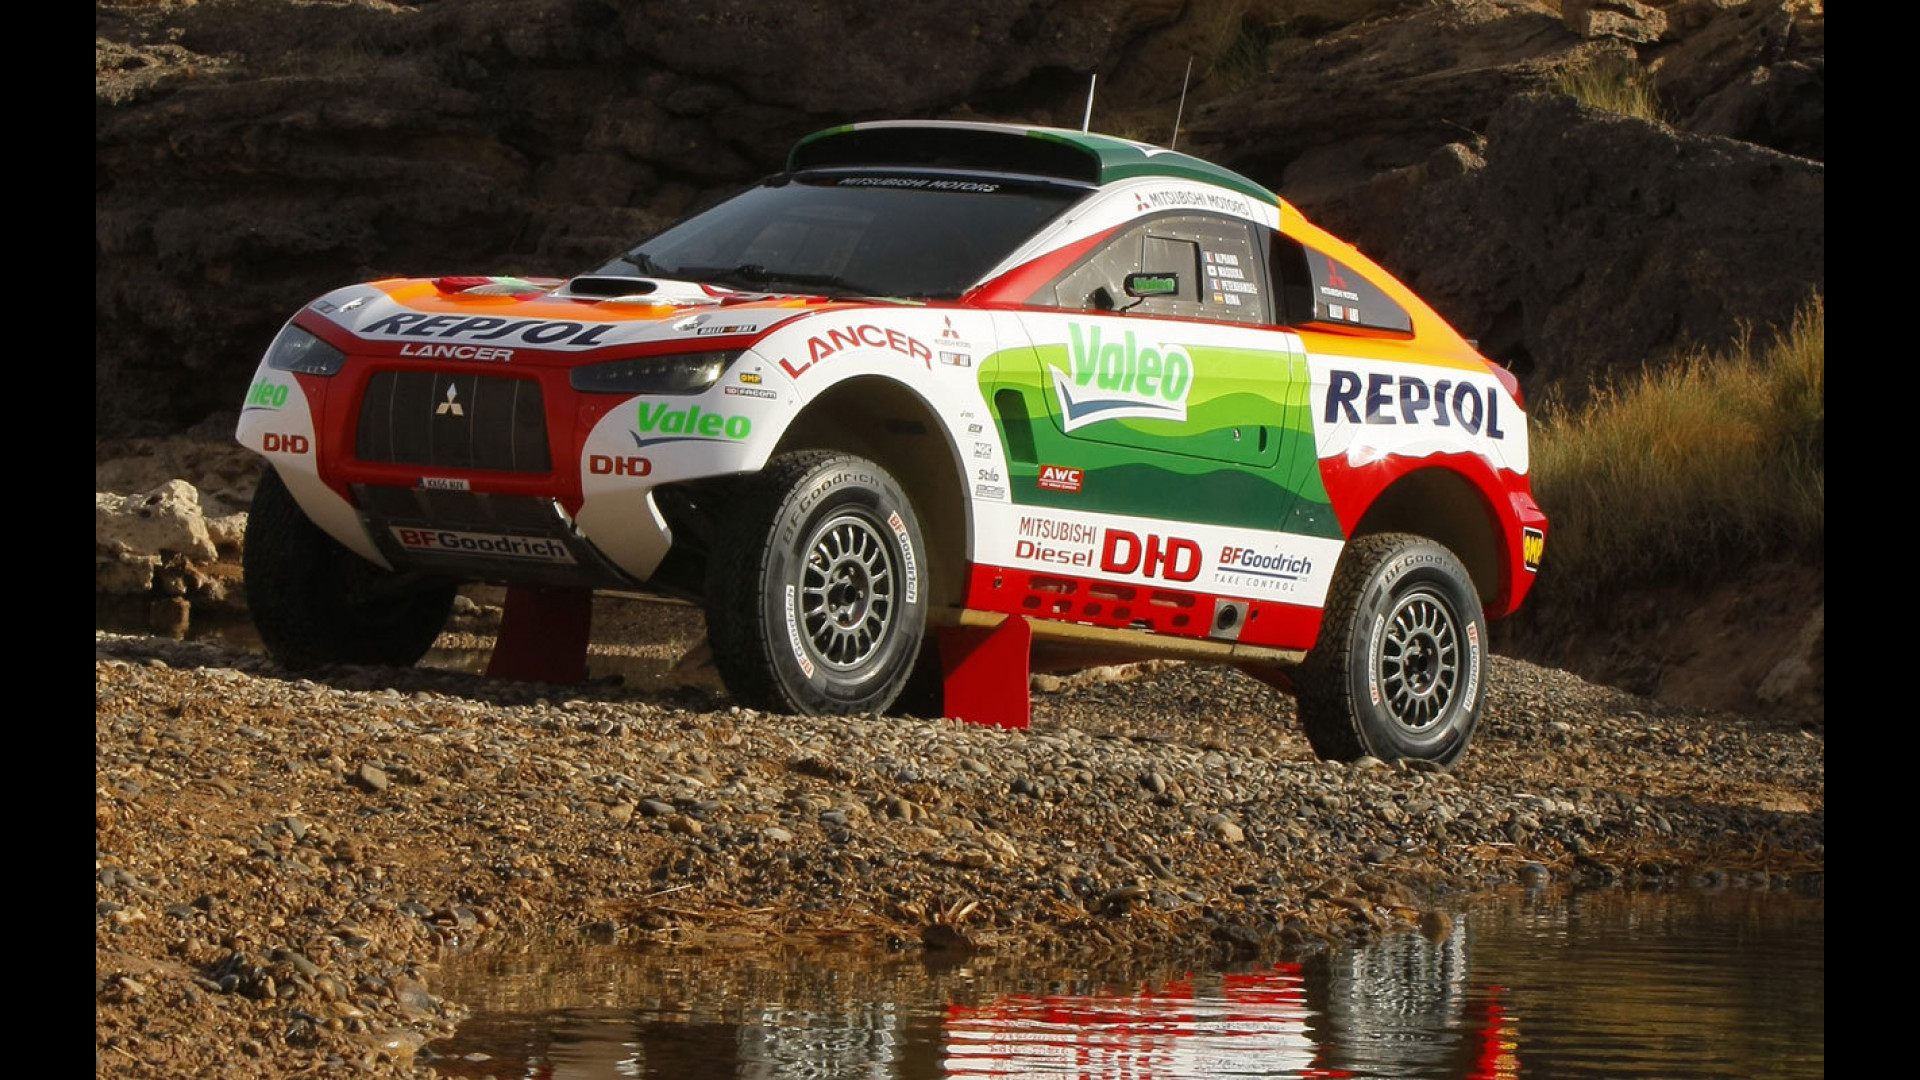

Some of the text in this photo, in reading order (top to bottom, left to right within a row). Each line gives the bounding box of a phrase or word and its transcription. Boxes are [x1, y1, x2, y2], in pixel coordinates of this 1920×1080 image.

[838, 177, 1000, 194] MITSUBISHI MOTORS
[1149, 191, 1250, 216] MITSUBISHI MOTORS
[359, 312, 618, 346] REPSOL
[400, 343, 515, 362] LANCER
[779, 324, 933, 380] LANCER
[1068, 322, 1190, 402] Valeo
[1323, 369, 1505, 440] REPSOL
[638, 401, 752, 440] Valeo
[1043, 467, 1080, 482] AWC
[782, 473, 880, 546] BFGoodrich
[400, 529, 567, 557] BFGoodrich
[1019, 517, 1097, 544] MITSUBISHI
[889, 514, 916, 602] BFGoodrich
[1015, 540, 1094, 567] Diesel
[1219, 545, 1312, 575] BFGoodrich
[1524, 535, 1543, 565] OMP
[1214, 573, 1240, 585] TAKE
[1246, 577, 1295, 592] CONTROL
